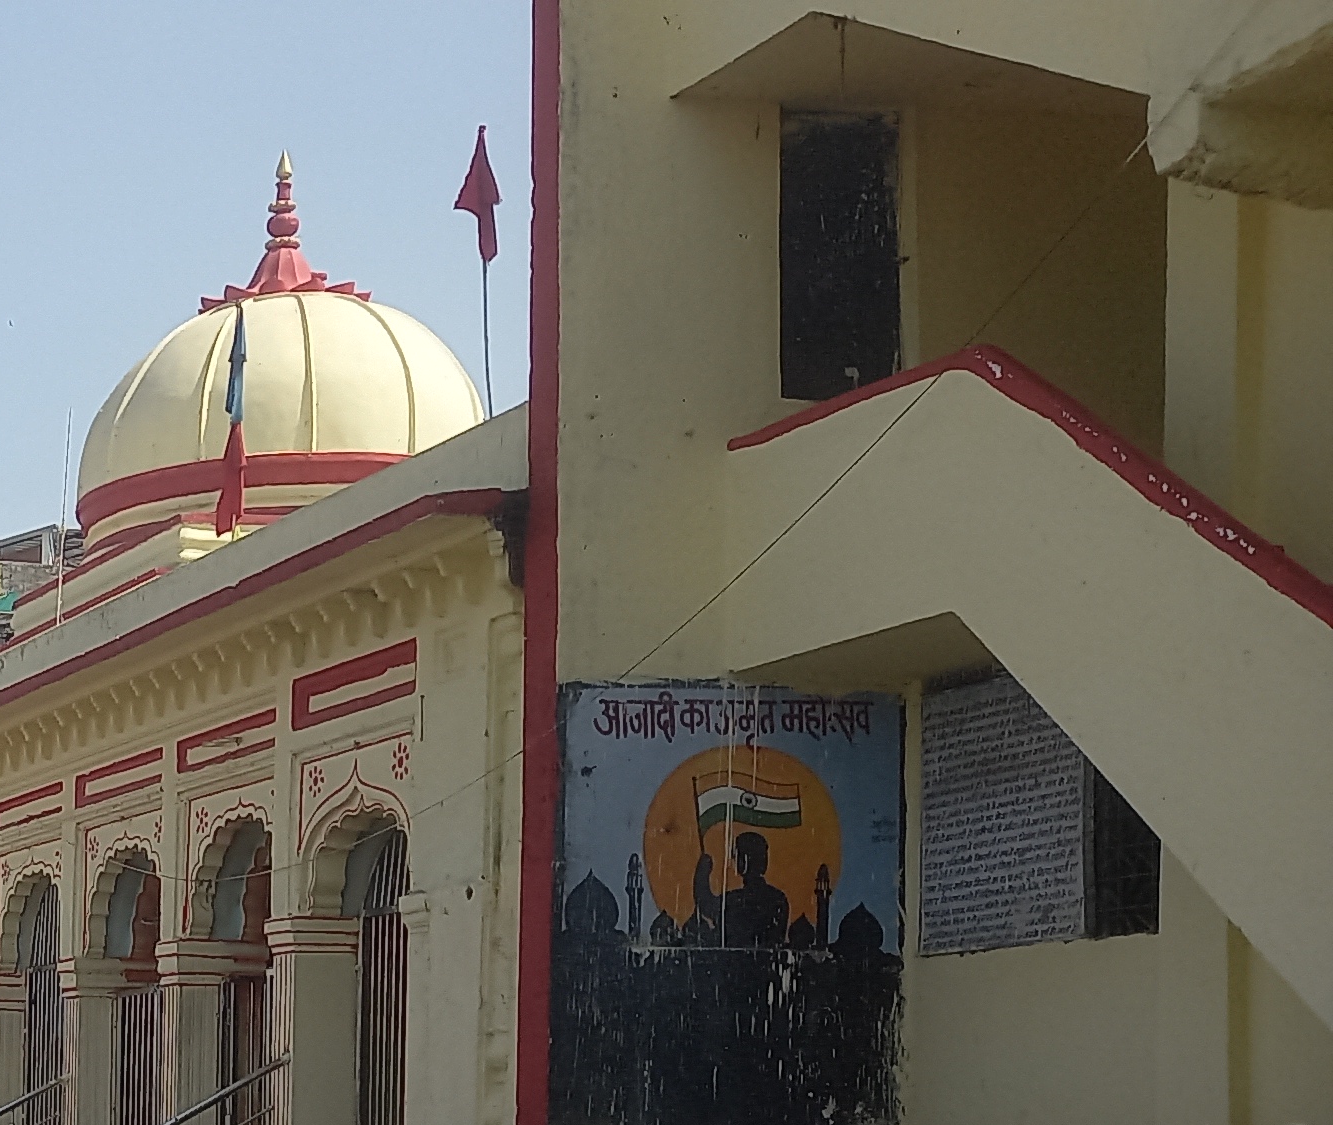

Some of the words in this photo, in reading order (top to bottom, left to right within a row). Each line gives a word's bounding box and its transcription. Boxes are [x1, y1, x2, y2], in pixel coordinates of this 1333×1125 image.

[593, 690, 679, 743] आजादी
[680, 698, 713, 734] का
[714, 699, 777, 750] अमृत
